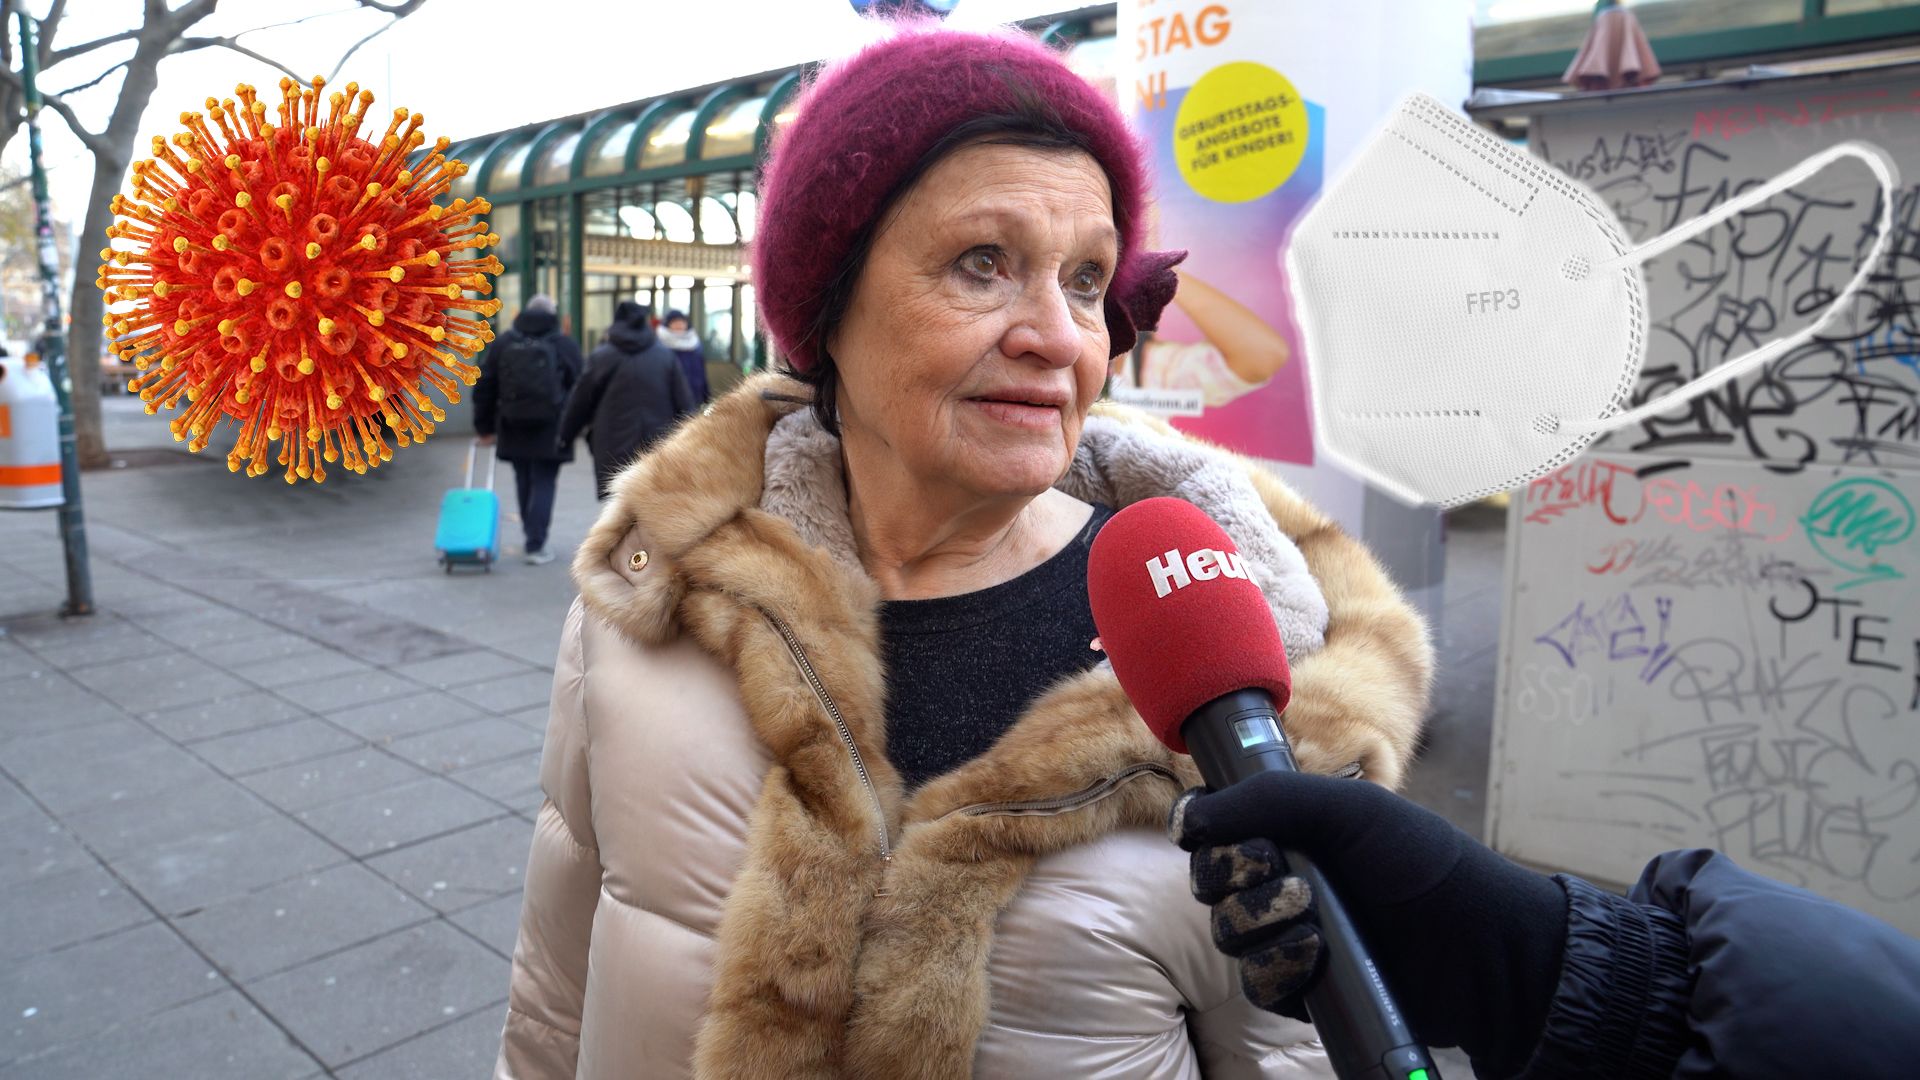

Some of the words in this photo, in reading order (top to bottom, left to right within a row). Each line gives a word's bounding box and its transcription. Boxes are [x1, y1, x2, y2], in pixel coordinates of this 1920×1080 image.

[1179, 94, 1295, 140] GEBURTSTAGS-
[1196, 115, 1281, 150] ANGEBOTE
[1192, 153, 1219, 172] FÜR
[1225, 131, 1295, 160] KINDER!
[1364, 958, 1401, 1027] SENNHEISER
